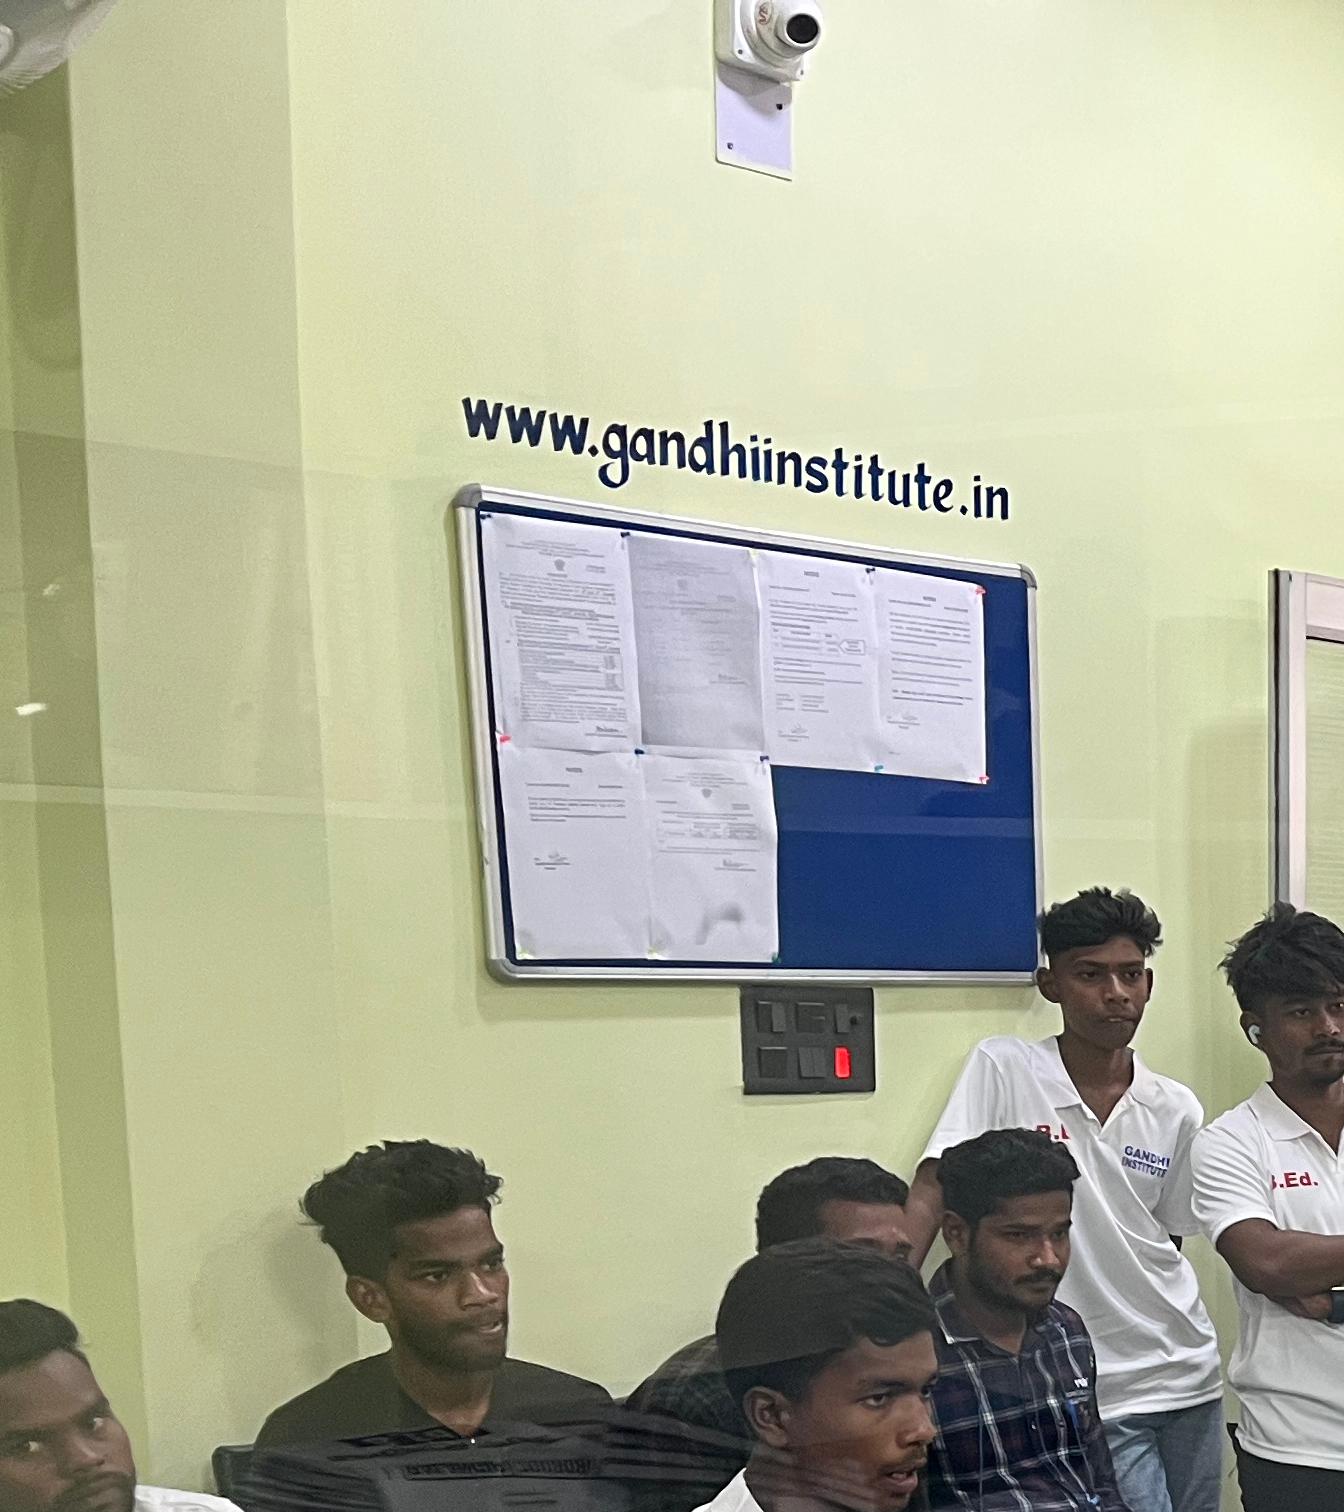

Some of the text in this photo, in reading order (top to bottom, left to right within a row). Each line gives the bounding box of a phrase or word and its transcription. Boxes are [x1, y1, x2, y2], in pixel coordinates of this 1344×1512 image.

[462, 397, 1010, 521] www.gandhiinstitute.in
[1122, 1157, 1168, 1178] INSTITUTE
[1124, 1145, 1170, 1168] GANDHI
